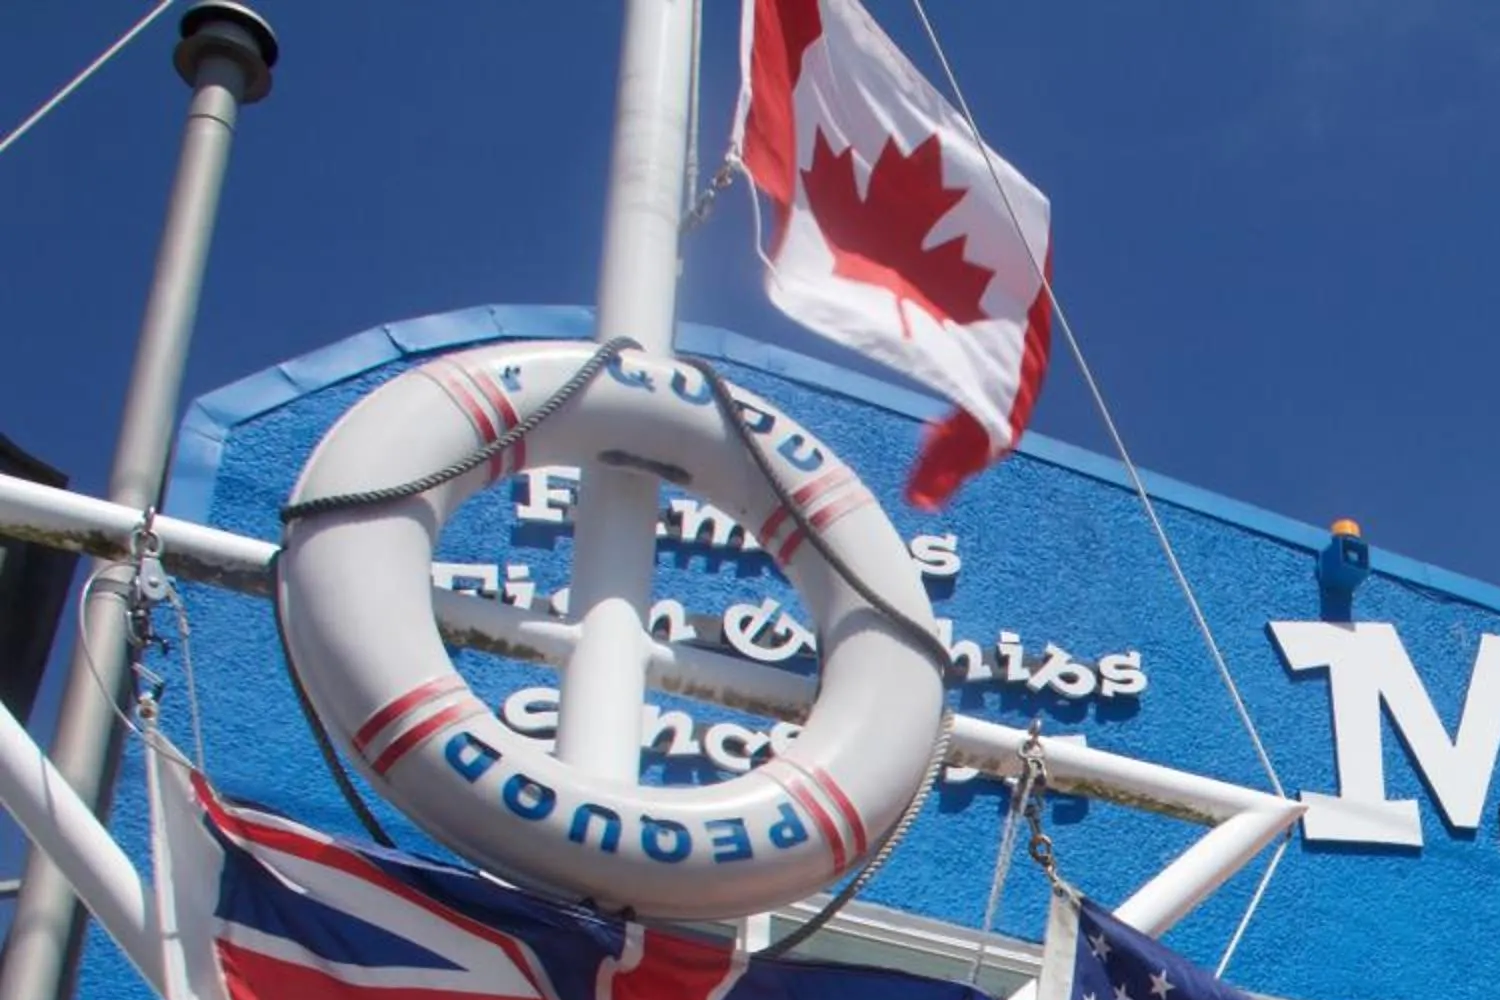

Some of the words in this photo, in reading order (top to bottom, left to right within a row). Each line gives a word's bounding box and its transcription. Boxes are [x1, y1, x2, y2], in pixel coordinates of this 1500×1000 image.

[723, 597, 817, 662] &
[934, 617, 1149, 698] hips
[444, 730, 810, 864] PEQUOD
